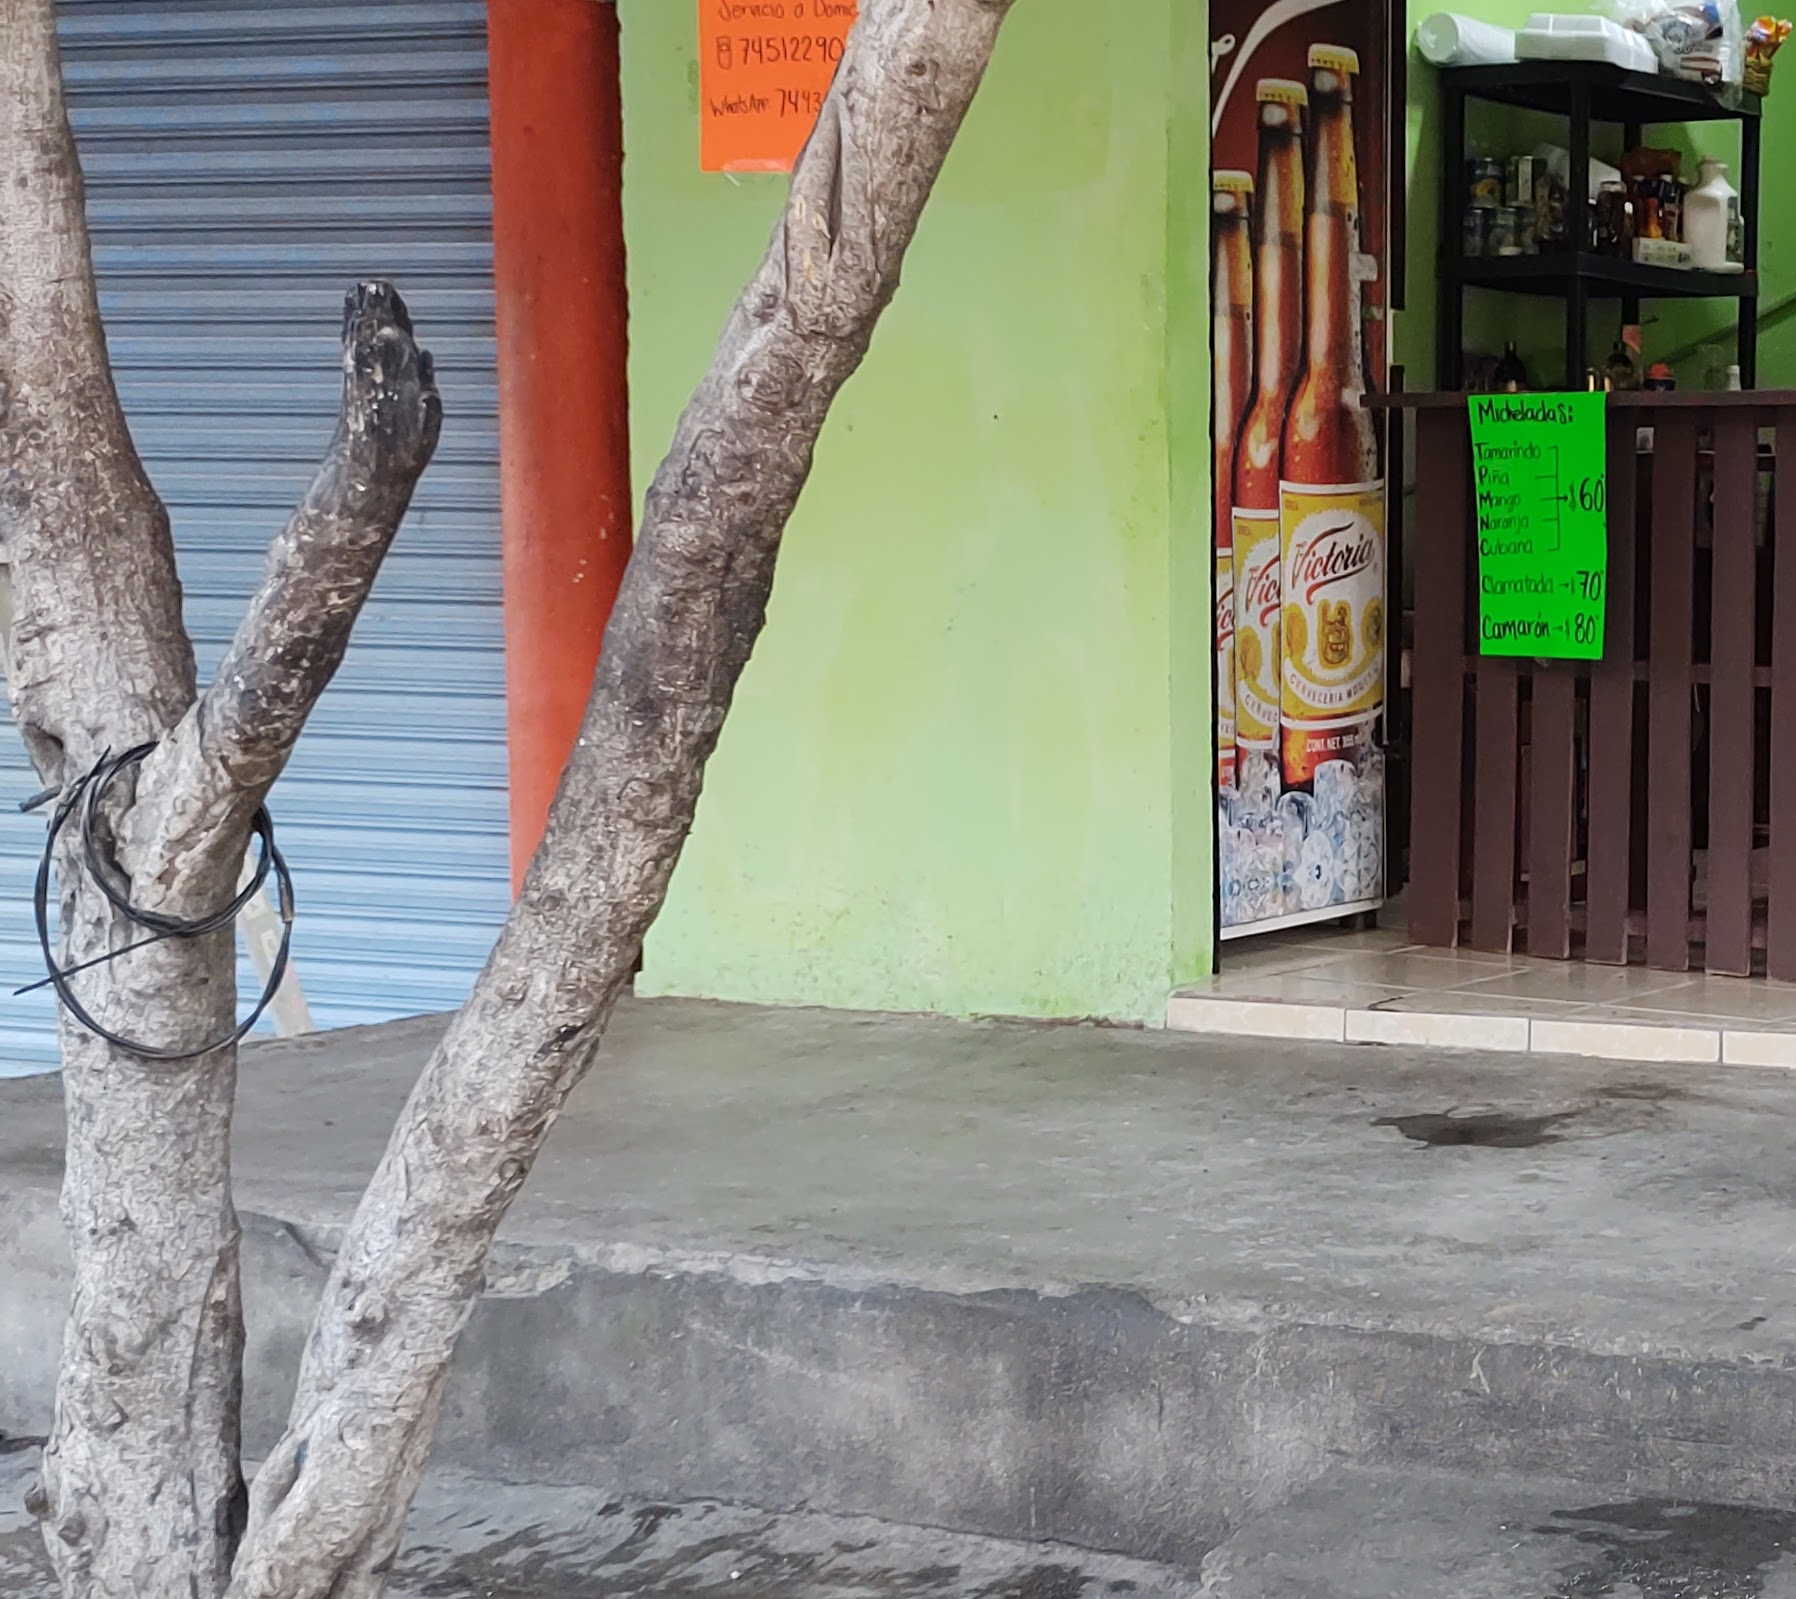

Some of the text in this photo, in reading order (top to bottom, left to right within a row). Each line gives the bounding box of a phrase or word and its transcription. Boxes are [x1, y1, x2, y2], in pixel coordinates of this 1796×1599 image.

[1475, 440, 1542, 461] Tamarindo
[1479, 490, 1521, 513] Mango
[1480, 513, 1529, 535] Naranja
[1480, 538, 1533, 556] Cubana
[1291, 521, 1375, 598] Victoria
